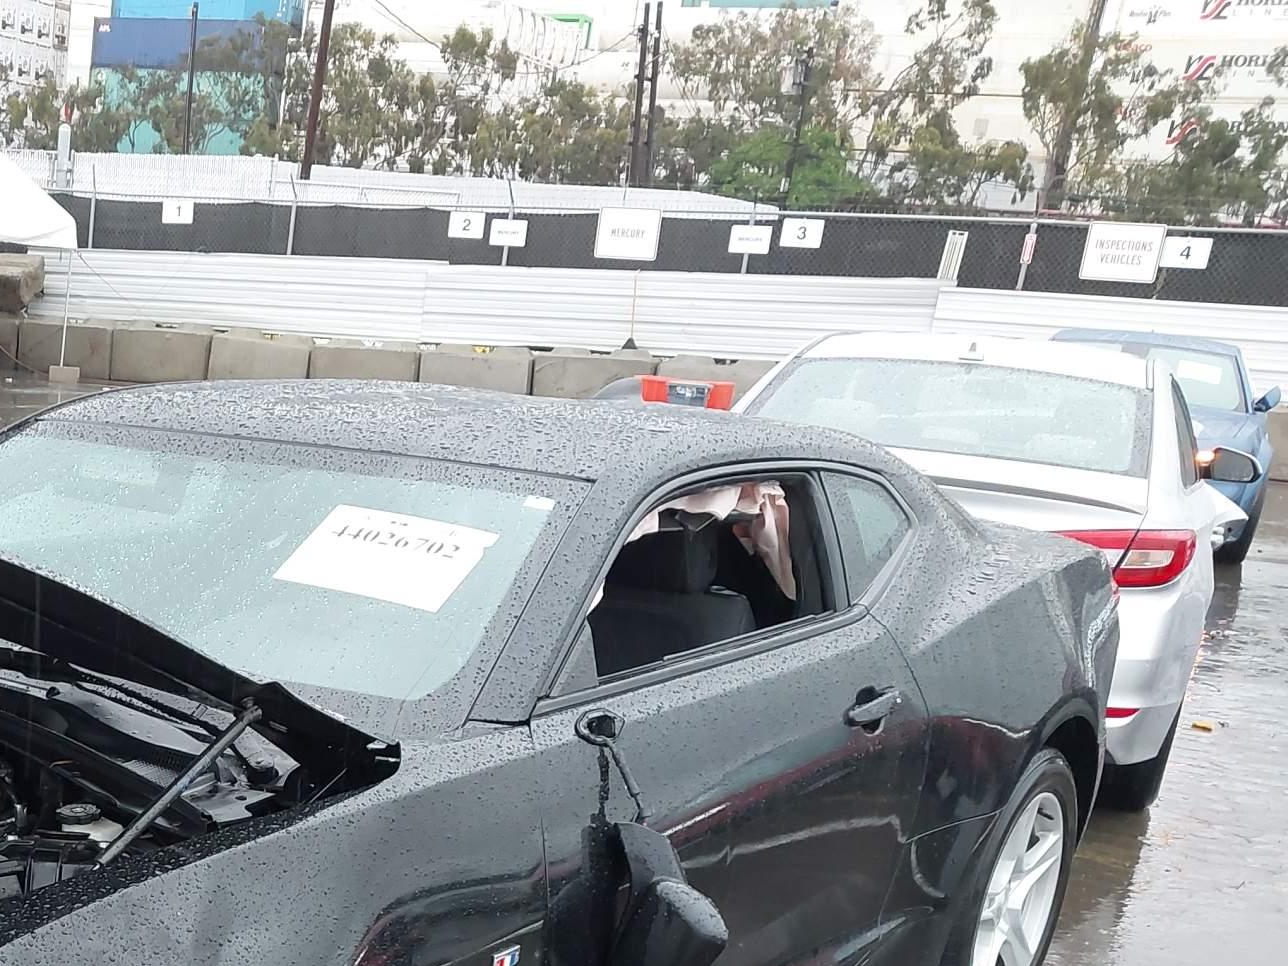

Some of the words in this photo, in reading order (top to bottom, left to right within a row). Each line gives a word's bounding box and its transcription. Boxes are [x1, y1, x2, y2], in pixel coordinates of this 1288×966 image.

[176, 205, 182, 217] 1
[462, 218, 472, 231] 2
[610, 227, 647, 239] MERCURY
[796, 226, 808, 240] 3
[1095, 239, 1155, 252] INSPECTIONS
[1179, 245, 1192, 260] 4
[1100, 253, 1142, 266] VEHICLES
[331, 524, 461, 559] 44026702
